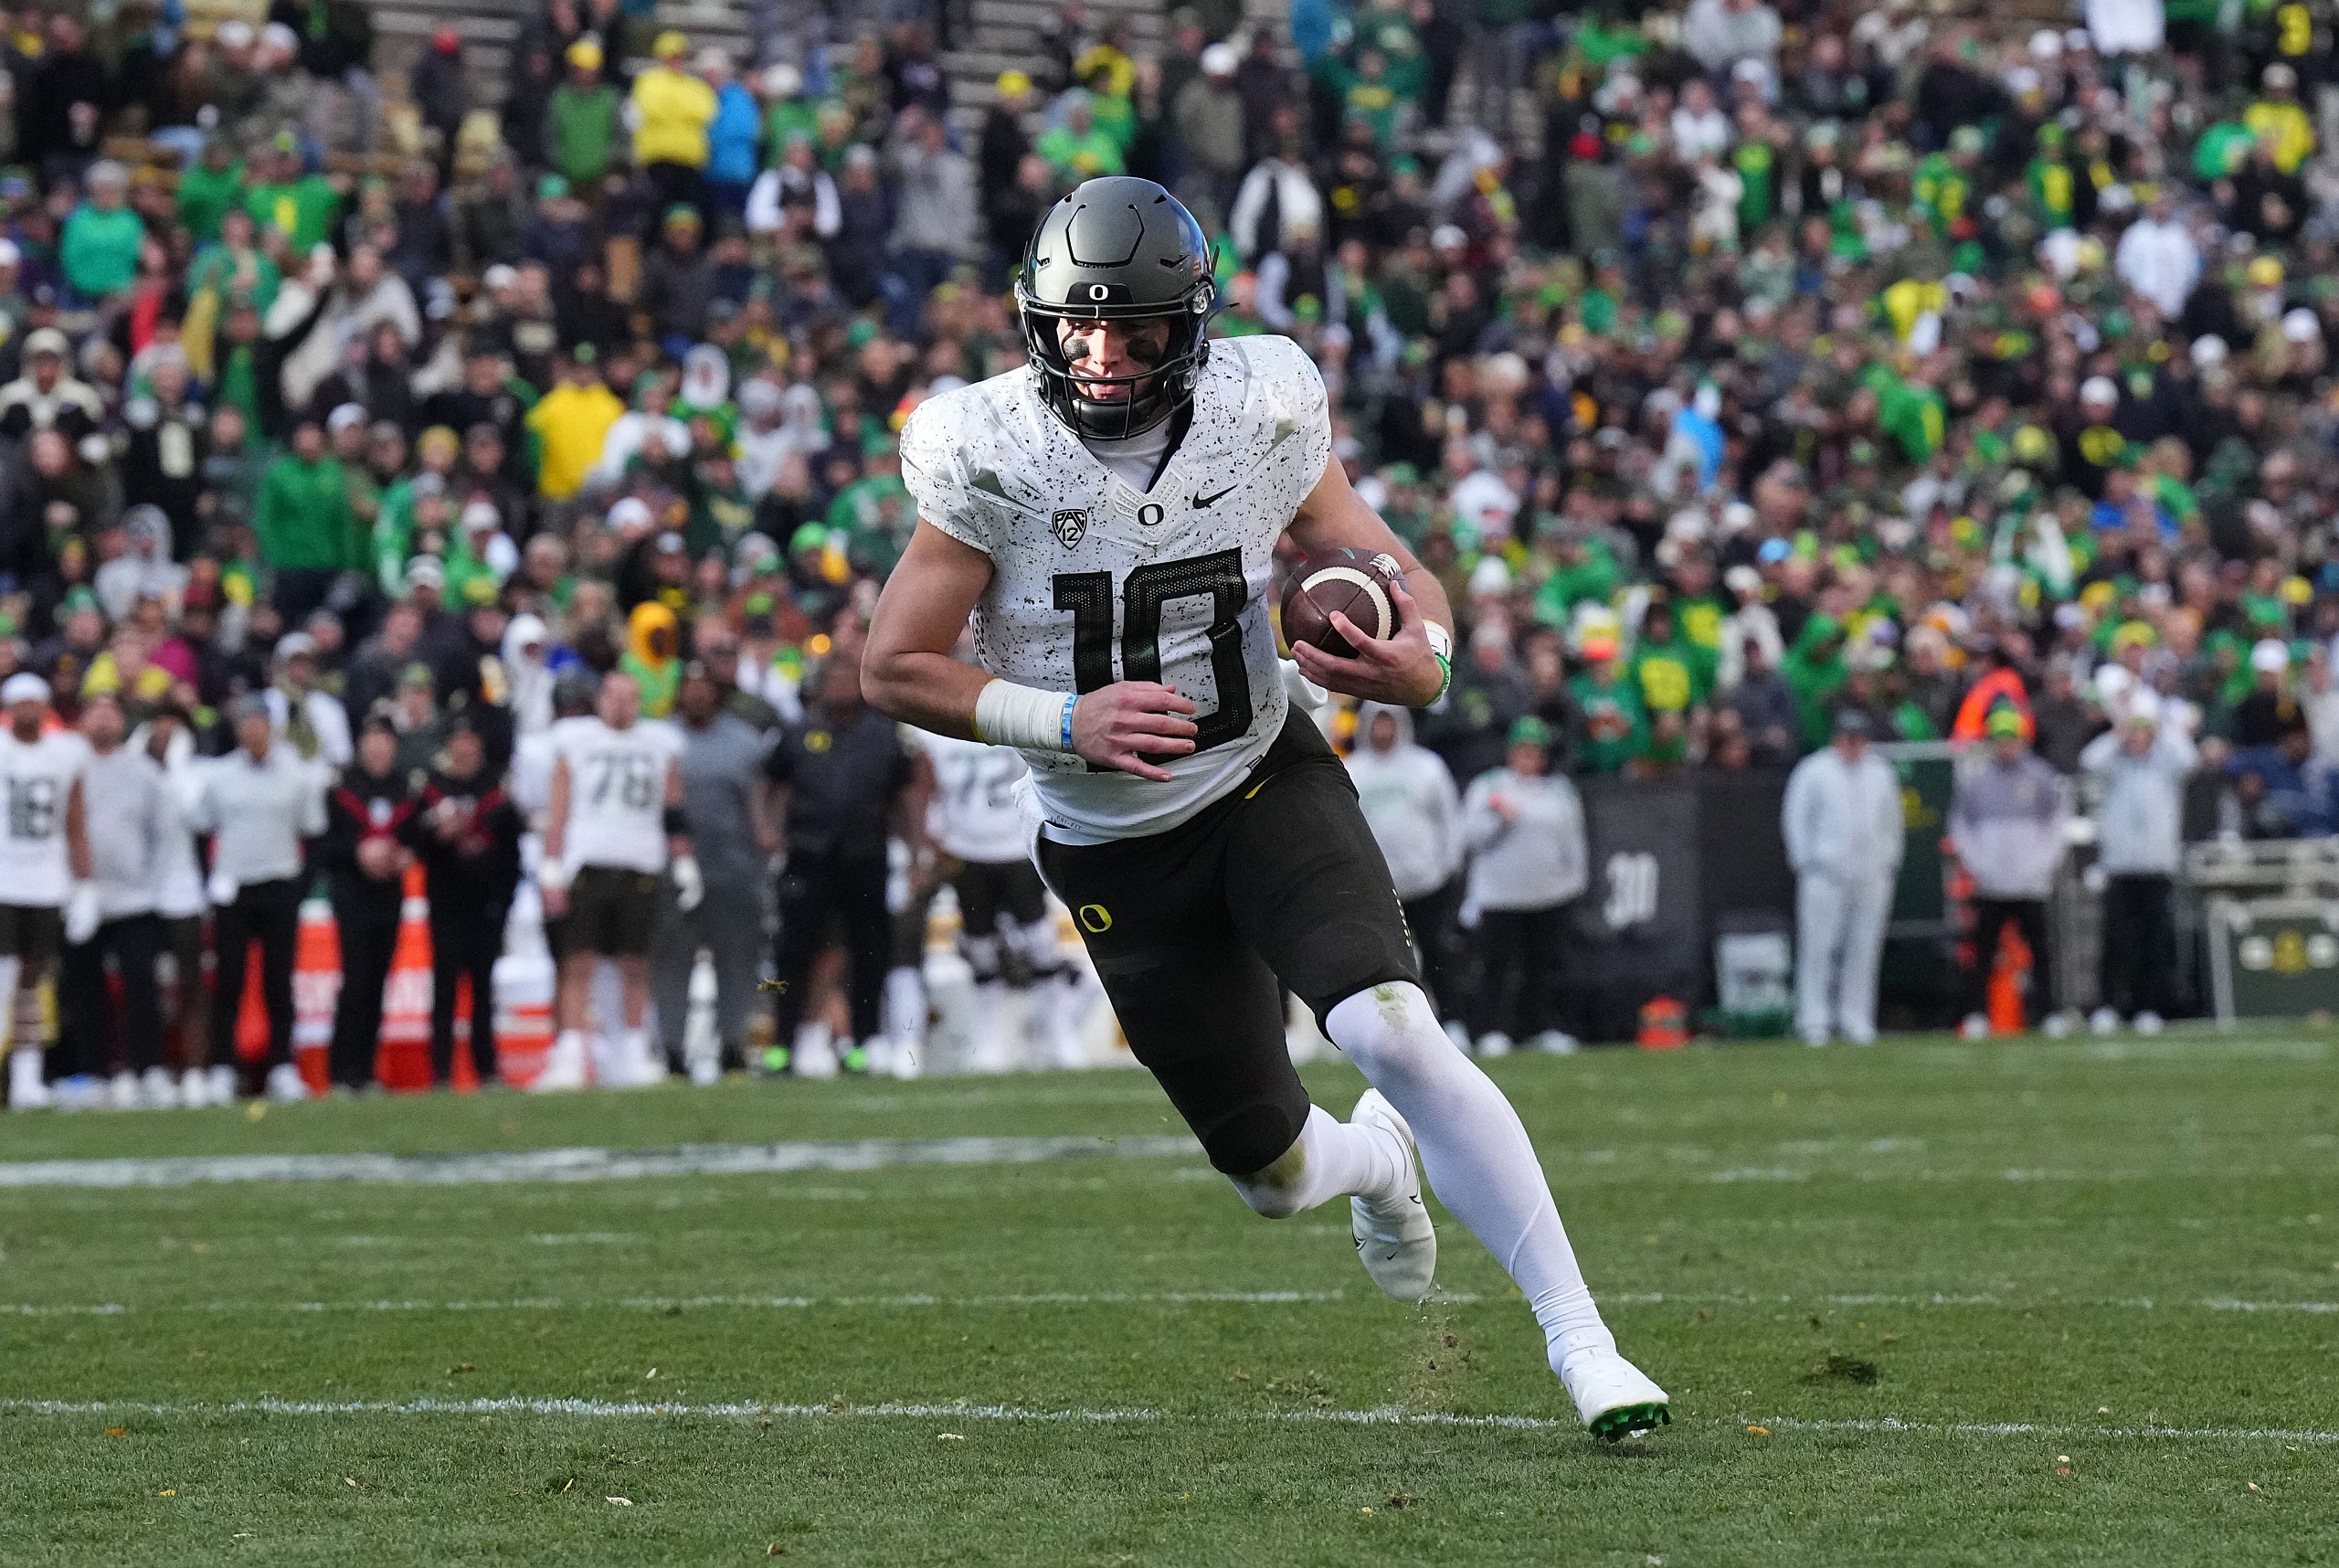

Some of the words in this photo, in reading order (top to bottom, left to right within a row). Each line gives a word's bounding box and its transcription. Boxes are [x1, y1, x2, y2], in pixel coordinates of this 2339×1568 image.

[1089, 284, 1109, 301] O
[1054, 511, 1085, 535] PAC
[1138, 503, 1164, 525] O
[1062, 527, 1079, 542] 12
[1052, 546, 1254, 773] 10
[1079, 904, 1113, 933] O
